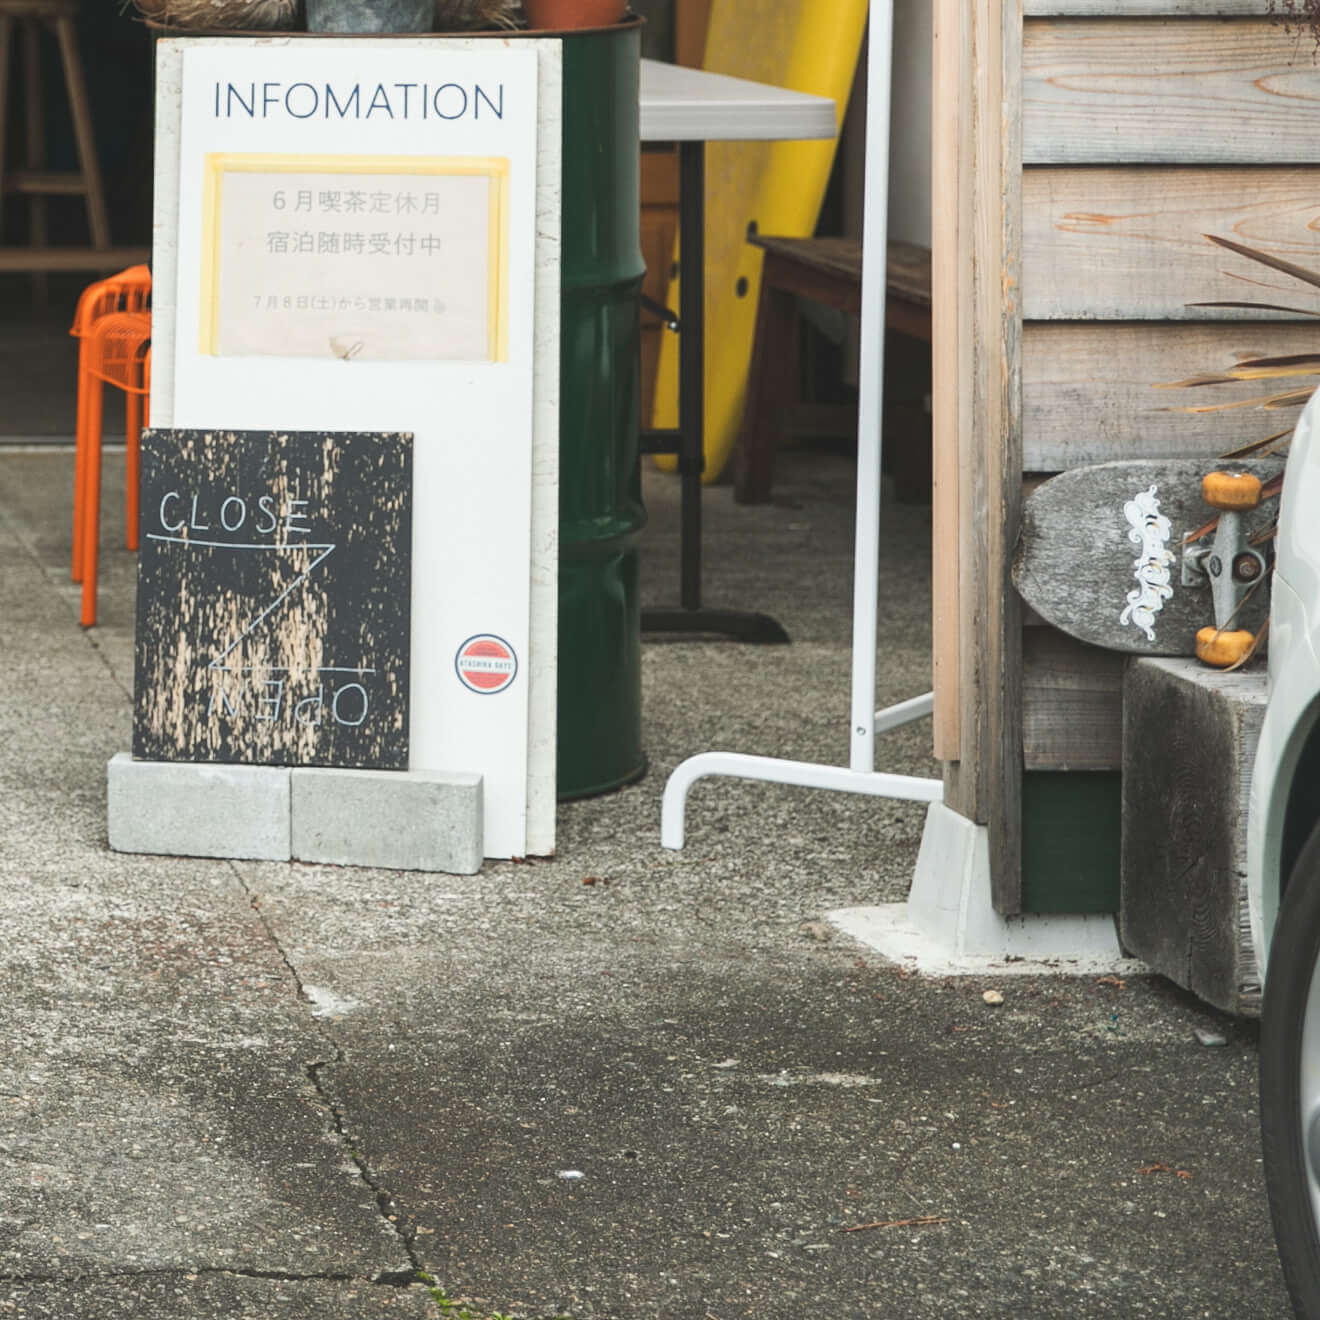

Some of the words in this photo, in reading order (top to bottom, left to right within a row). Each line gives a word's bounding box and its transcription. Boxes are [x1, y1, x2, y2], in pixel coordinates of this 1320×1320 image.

[214, 81, 505, 120] INFOMATION
[266, 231, 442, 257] 宿泊随時受付中
[160, 492, 312, 534] CLOSE
[207, 681, 369, 727] OPEN
